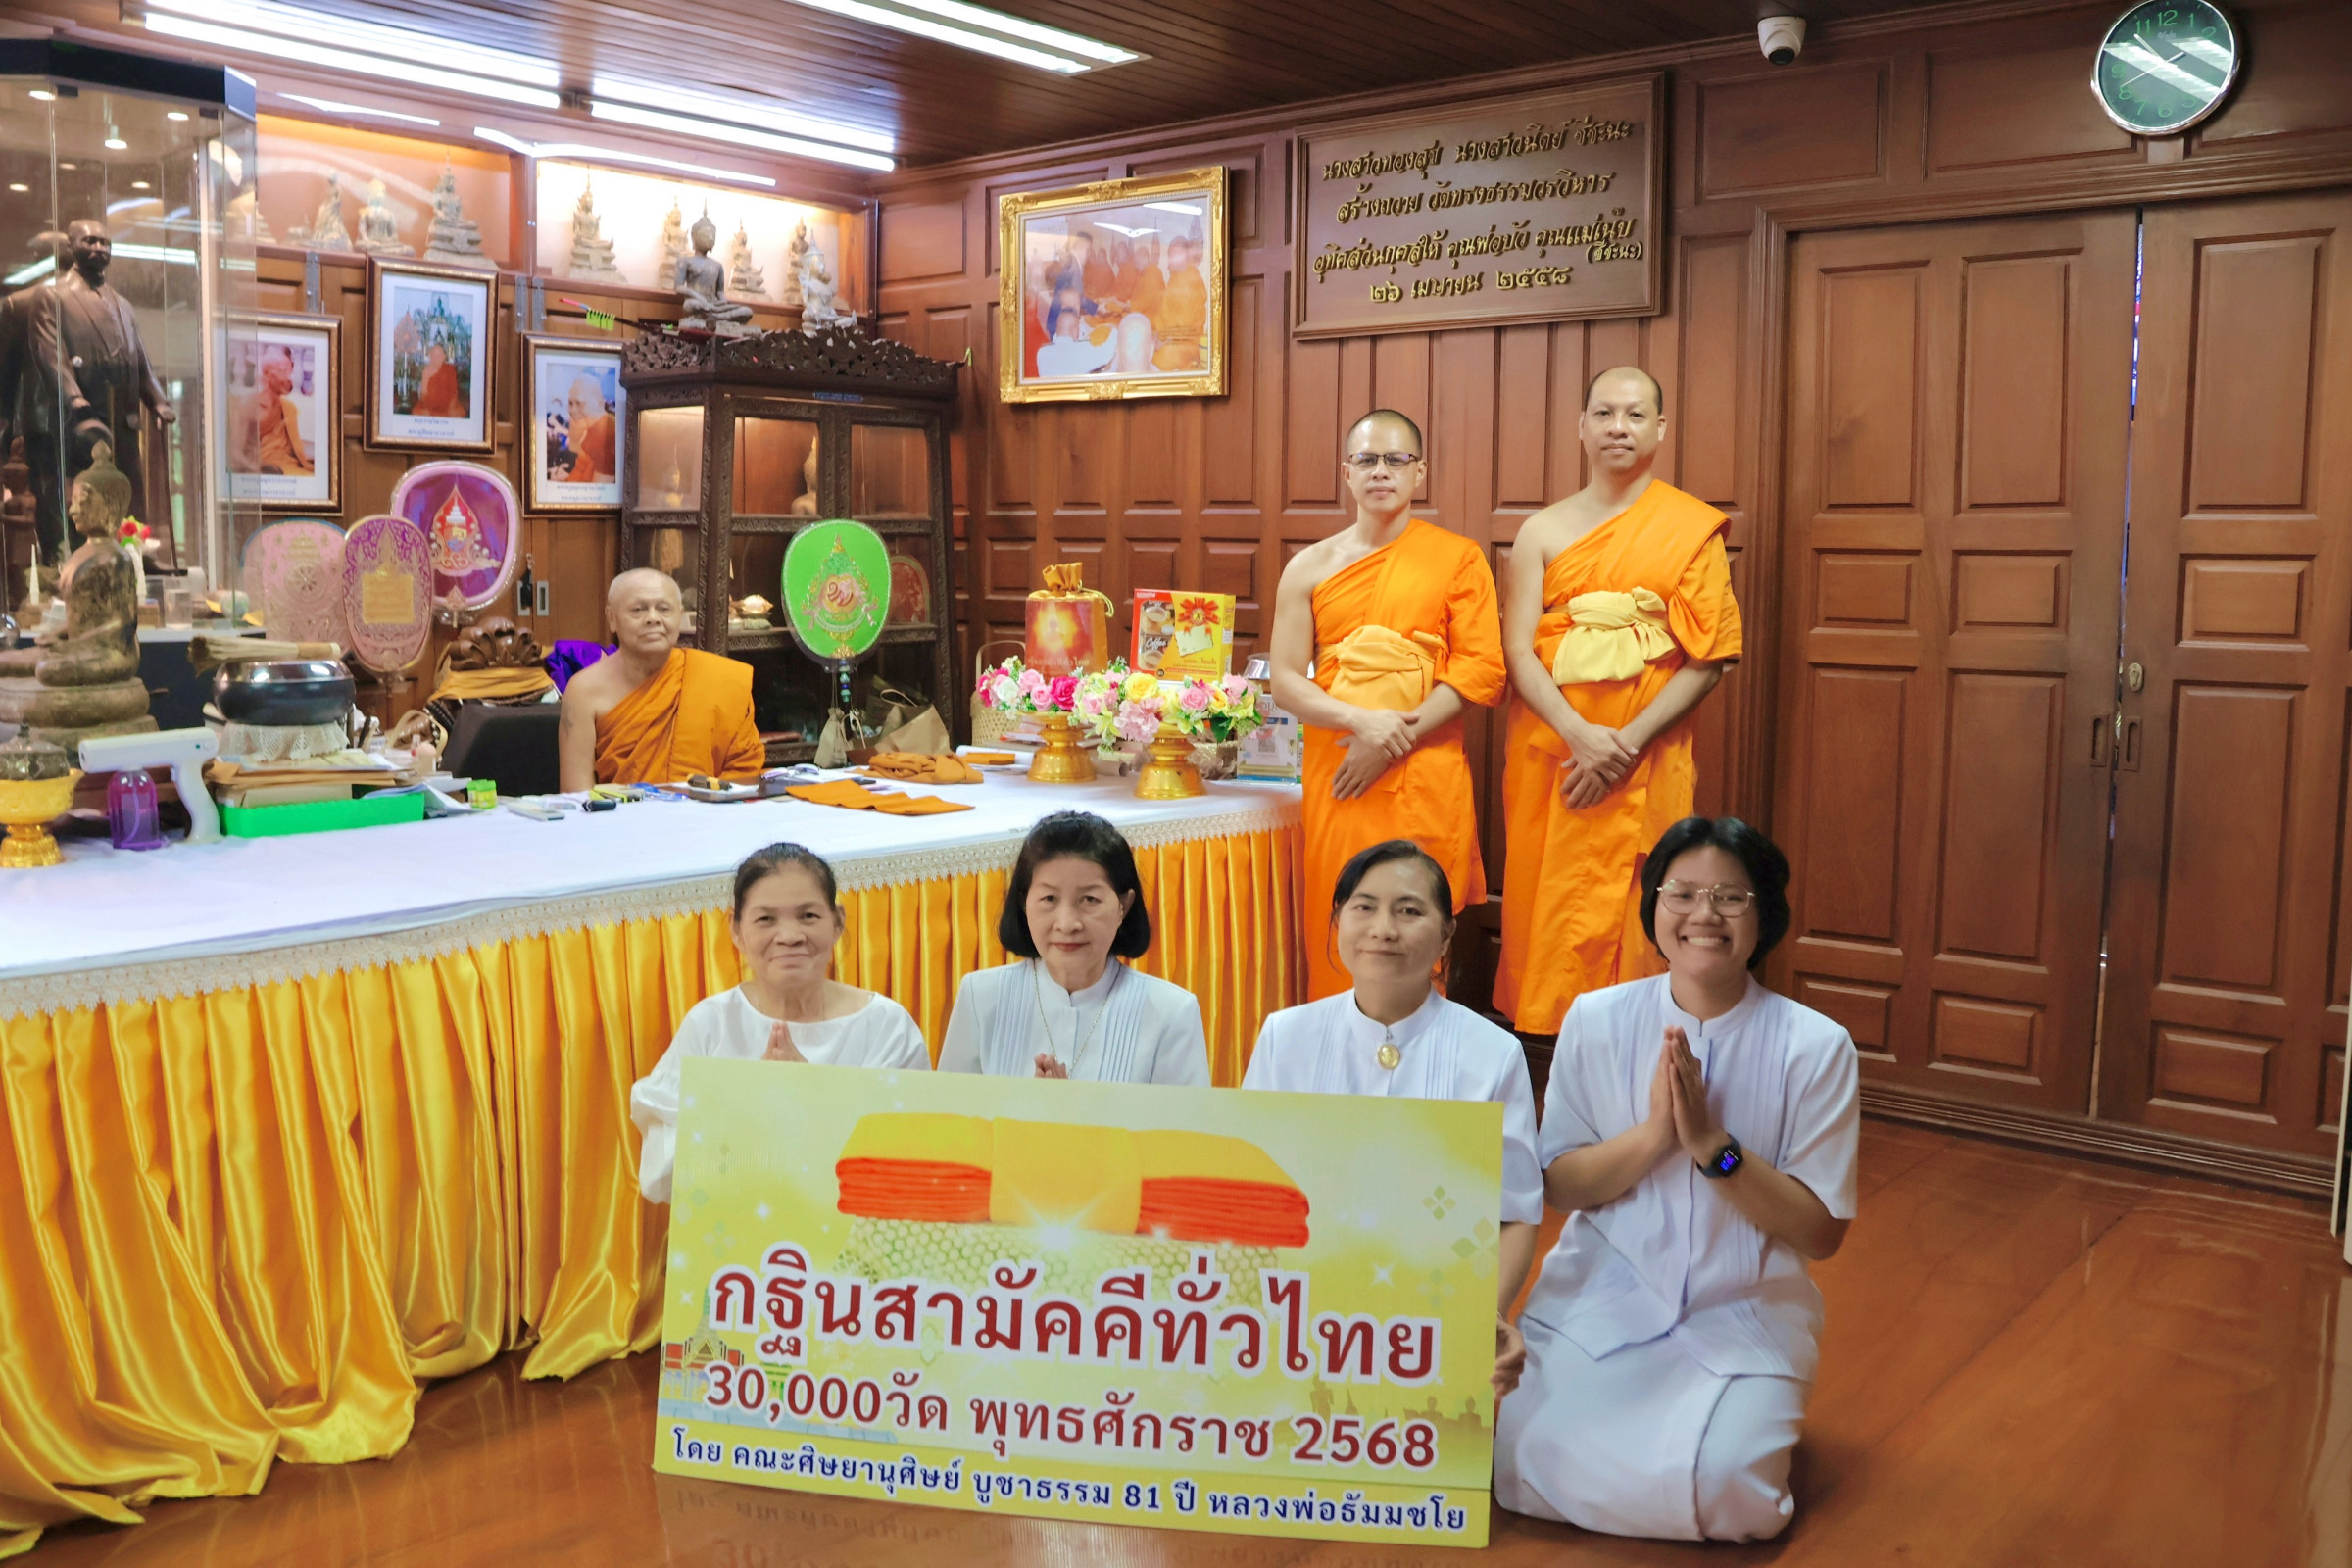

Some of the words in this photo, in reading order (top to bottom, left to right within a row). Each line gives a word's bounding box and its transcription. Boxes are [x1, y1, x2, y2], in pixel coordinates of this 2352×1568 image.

[2135, 19, 2151, 34] 11
[2157, 9, 2178, 26] 12
[2158, 102, 2173, 118] 6
[1336, 183, 1424, 223] สร้างถวาย
[1427, 168, 1616, 211] วัดทรงธรรมวรวิหาร
[1312, 229, 1448, 283] อุทิศส่วนกุศลให้
[1447, 220, 1531, 270] คุณพ่อบัว
[1370, 281, 1404, 304] ๒๖
[1410, 271, 1485, 299] เมษายน
[1495, 266, 1574, 291] ๒๕๕๘
[713, 1248, 1435, 1380] กฐินสามัคคีทั่วไทย
[707, 1363, 949, 1432] 30,000วัด
[968, 1390, 1271, 1458] พุทธศักราช
[1293, 1416, 1435, 1467] 2568
[673, 1427, 722, 1462] โดย
[733, 1445, 961, 1494] คณะศิษยานุศิษย์
[972, 1471, 1111, 1506] บูชาธรรม
[1124, 1484, 1161, 1510] 81
[1175, 1481, 1196, 1513] ปี
[1208, 1492, 1466, 1531] หลวงพ่อธัมมชโย
